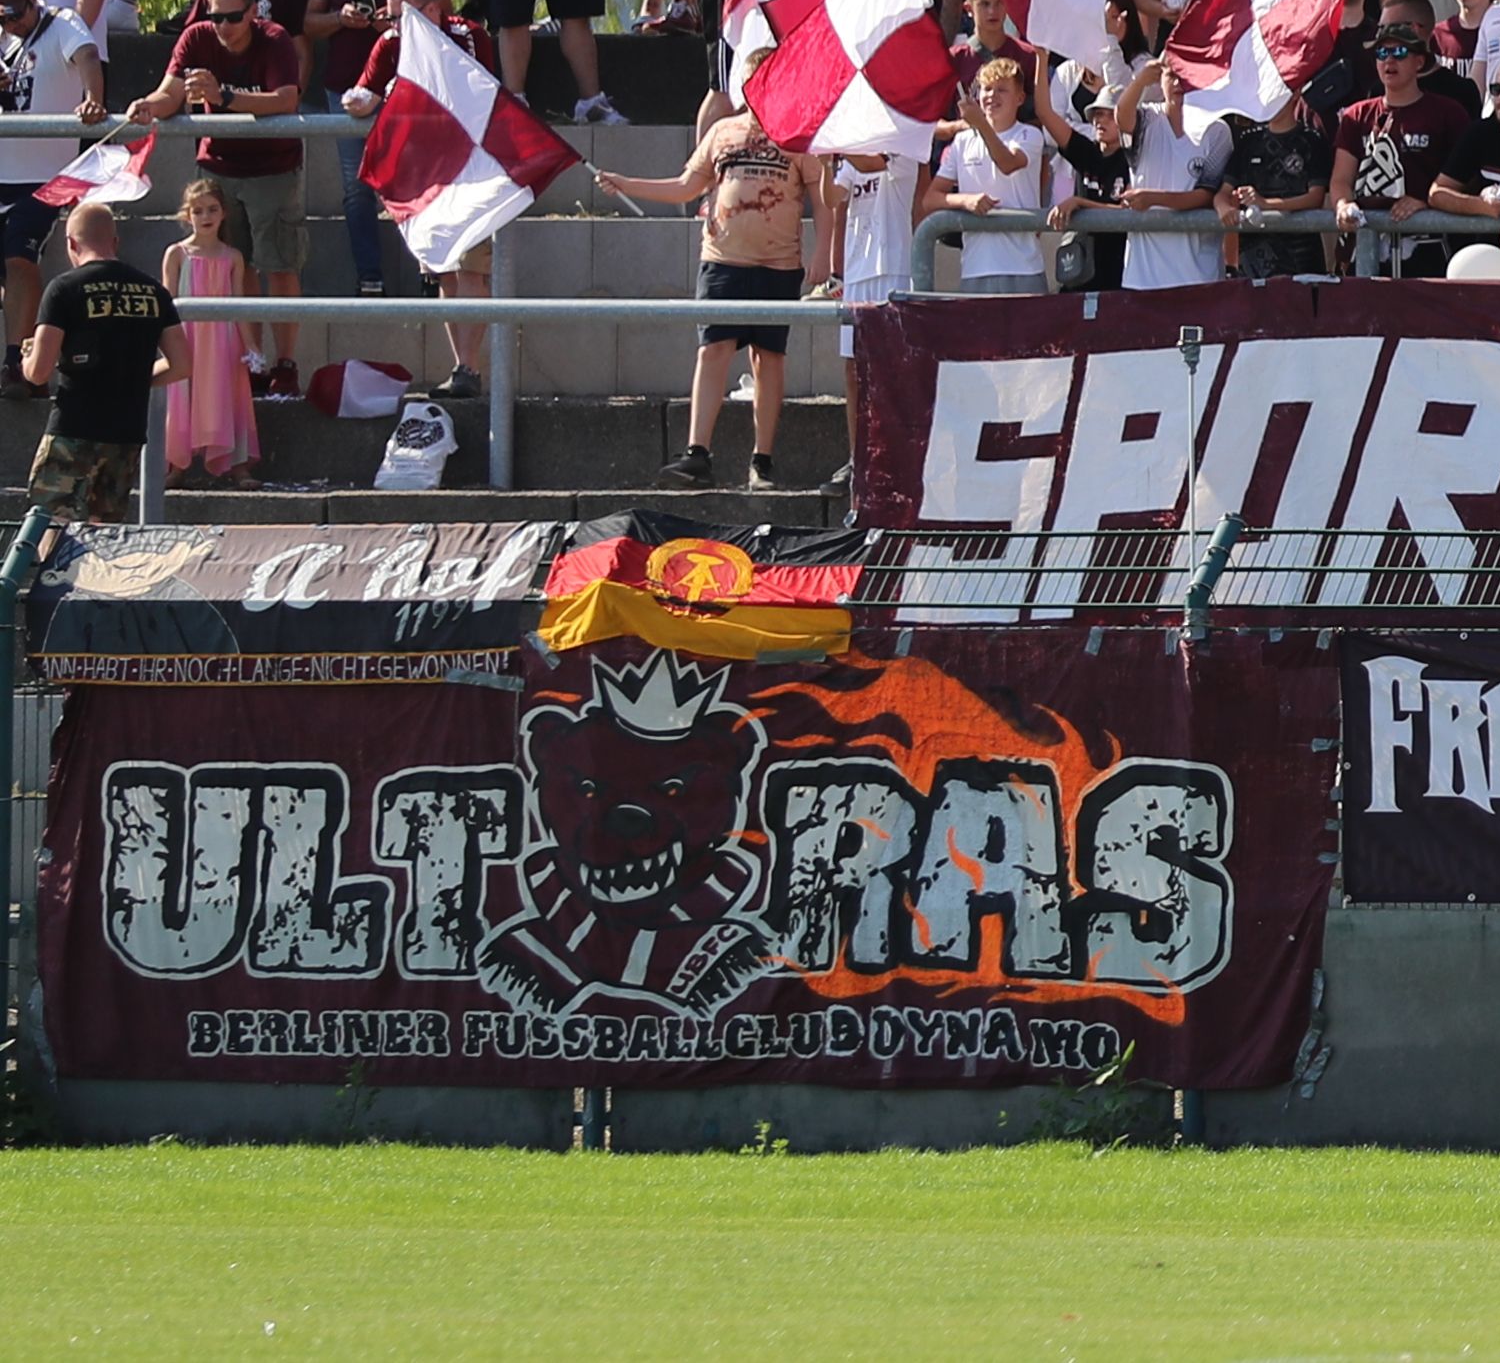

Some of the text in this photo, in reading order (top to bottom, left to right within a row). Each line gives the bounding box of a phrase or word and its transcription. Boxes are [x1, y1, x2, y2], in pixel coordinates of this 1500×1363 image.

[83, 281, 156, 295] SPORT
[86, 294, 160, 319] FREI
[140, 658, 167, 682] IHR
[173, 657, 229, 683] NOCH
[239, 657, 303, 682] LANGE
[309, 656, 370, 681] NICHT
[189, 1010, 451, 1057] BERLINER
